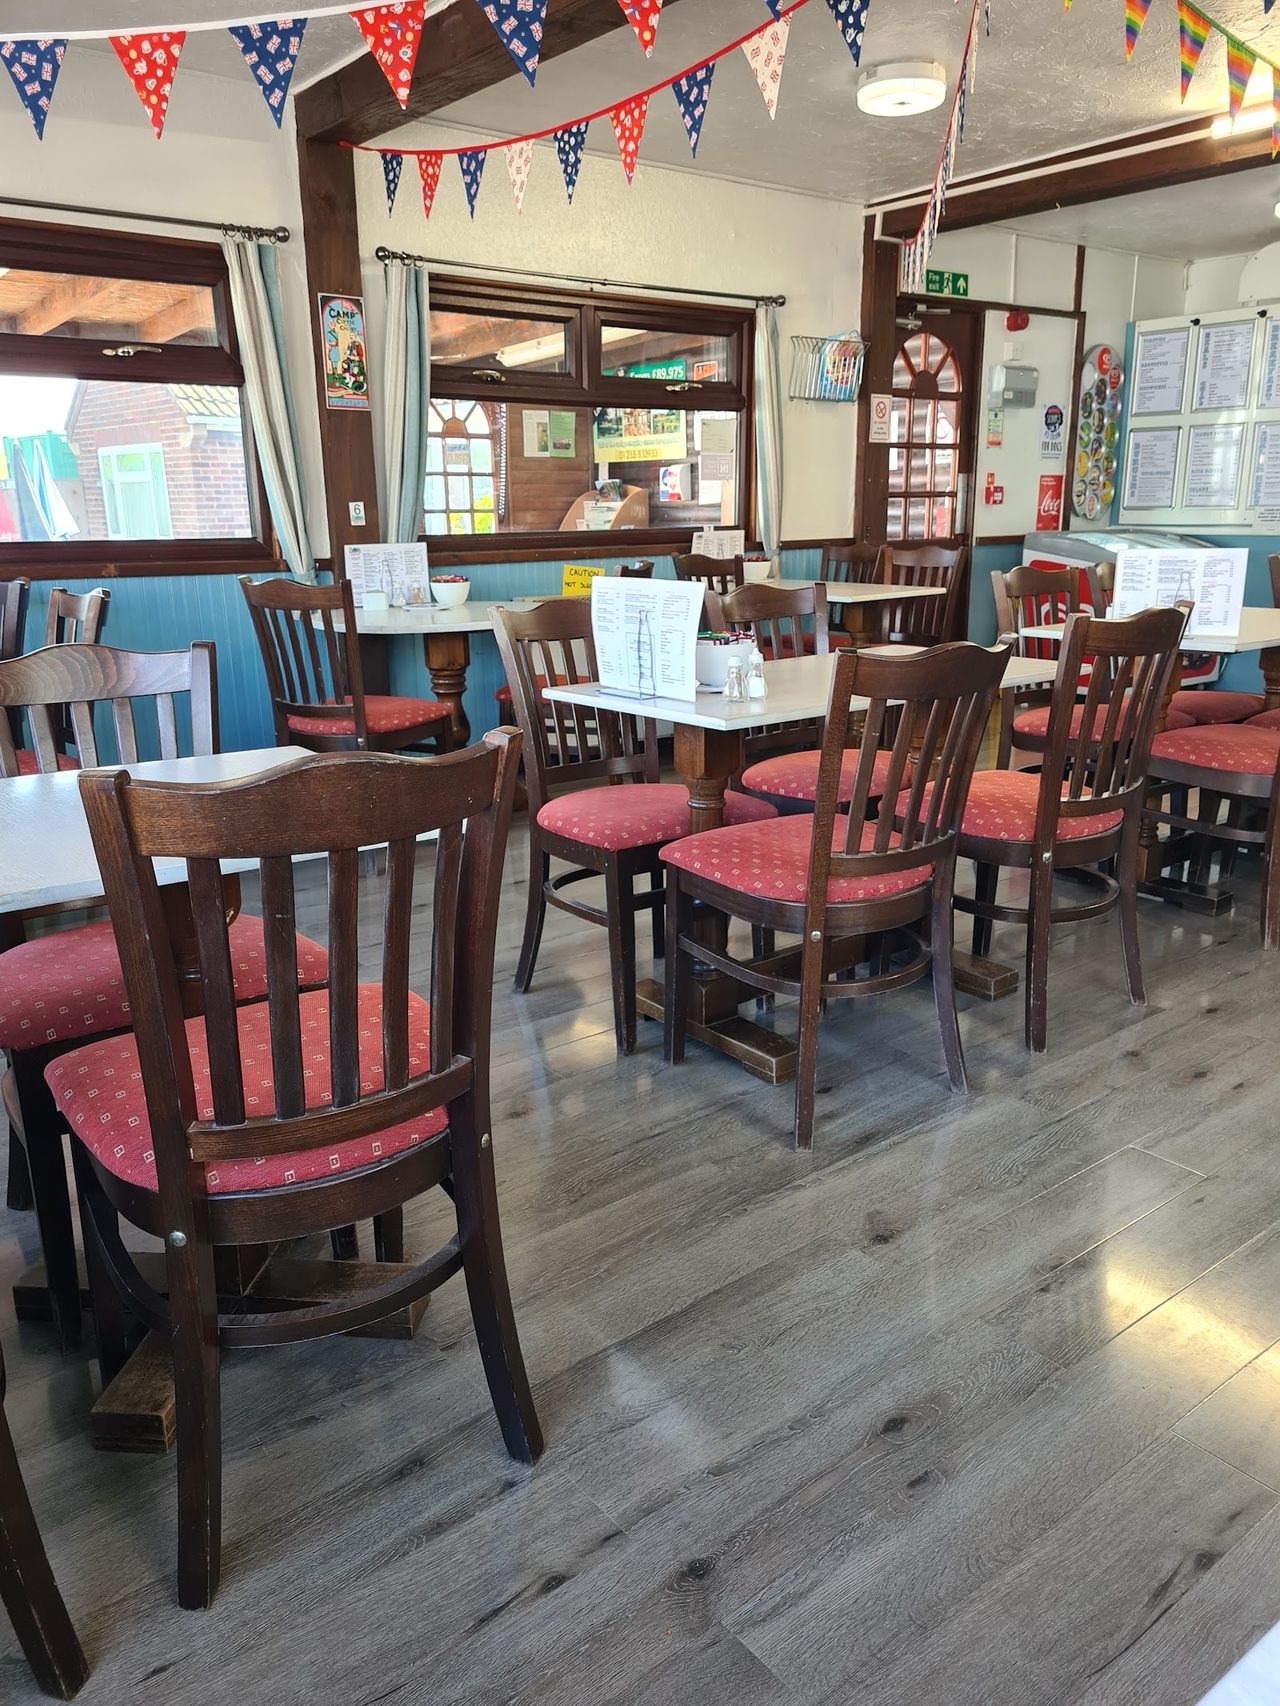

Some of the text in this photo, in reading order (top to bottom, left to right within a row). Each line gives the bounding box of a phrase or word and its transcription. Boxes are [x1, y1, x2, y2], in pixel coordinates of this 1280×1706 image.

[928, 272, 940, 281] Fire
[928, 282, 940, 291] exit
[1041, 440, 1062, 452] FOR DOGS
[353, 503, 361, 515] 6
[569, 568, 600, 577] CAUTION
